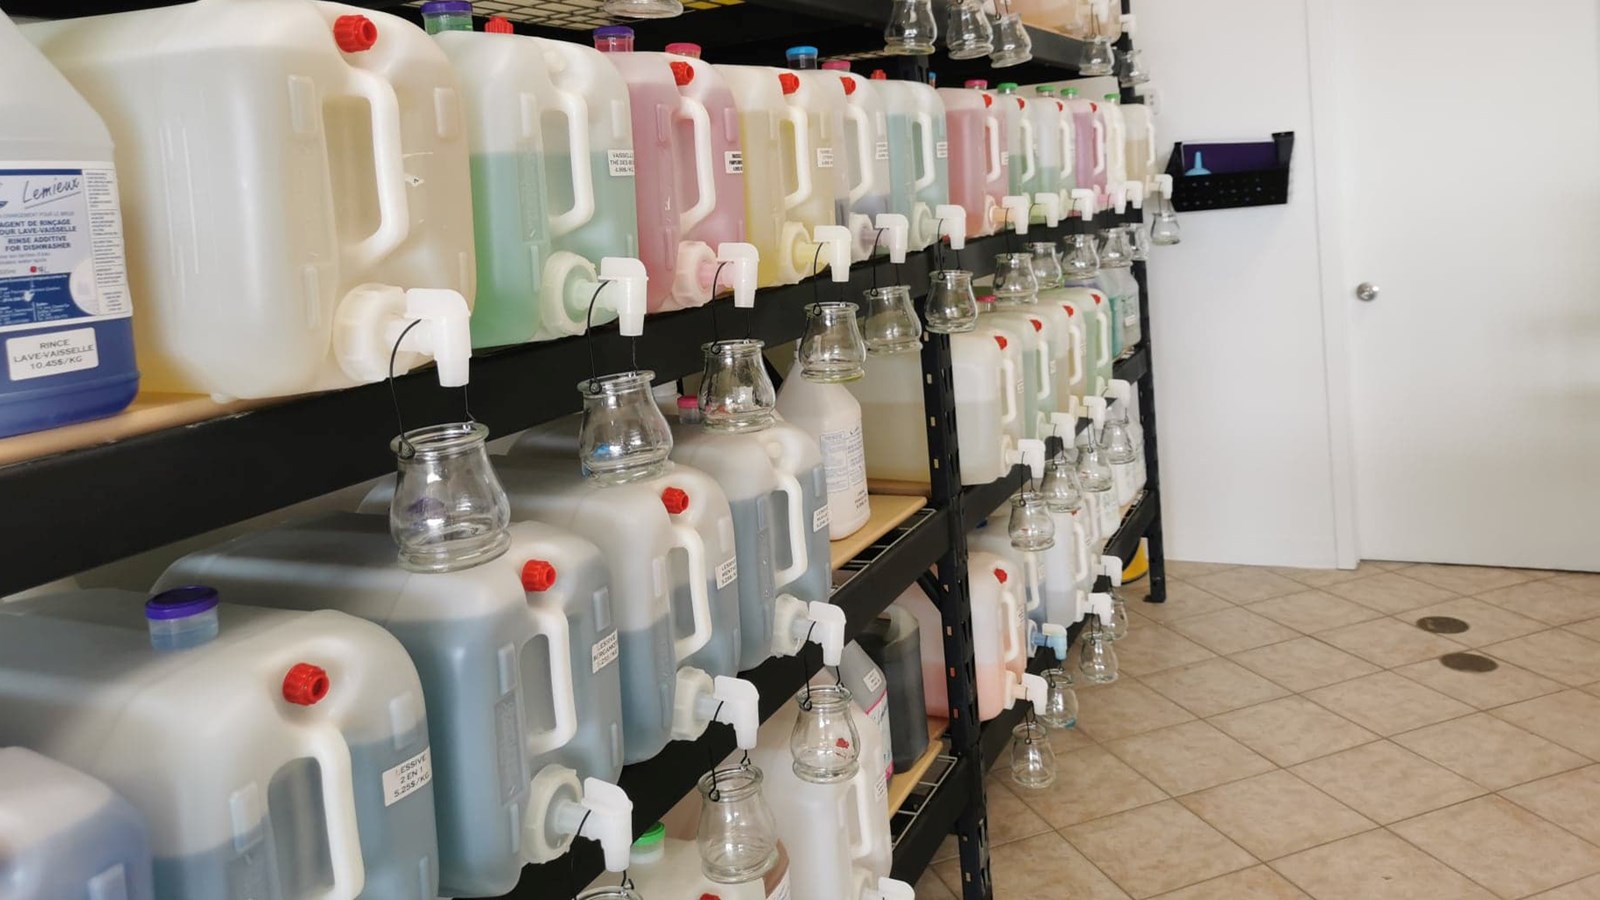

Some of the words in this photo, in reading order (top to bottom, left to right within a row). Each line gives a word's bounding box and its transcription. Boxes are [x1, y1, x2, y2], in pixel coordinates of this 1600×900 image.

[23, 177, 80, 204] Lemieux
[40, 218, 71, 226] RINÇAGE
[18, 225, 77, 235] LAVE-VAISSELLE
[34, 235, 67, 243] ADDITIVE
[23, 242, 71, 251] DISHWASHER
[40, 339, 71, 349] RINCE
[14, 344, 95, 363] LAVE-VAISSELLE
[395, 753, 427, 776] LESSIVE
[401, 775, 406, 785] 2
[407, 770, 418, 780] EN
